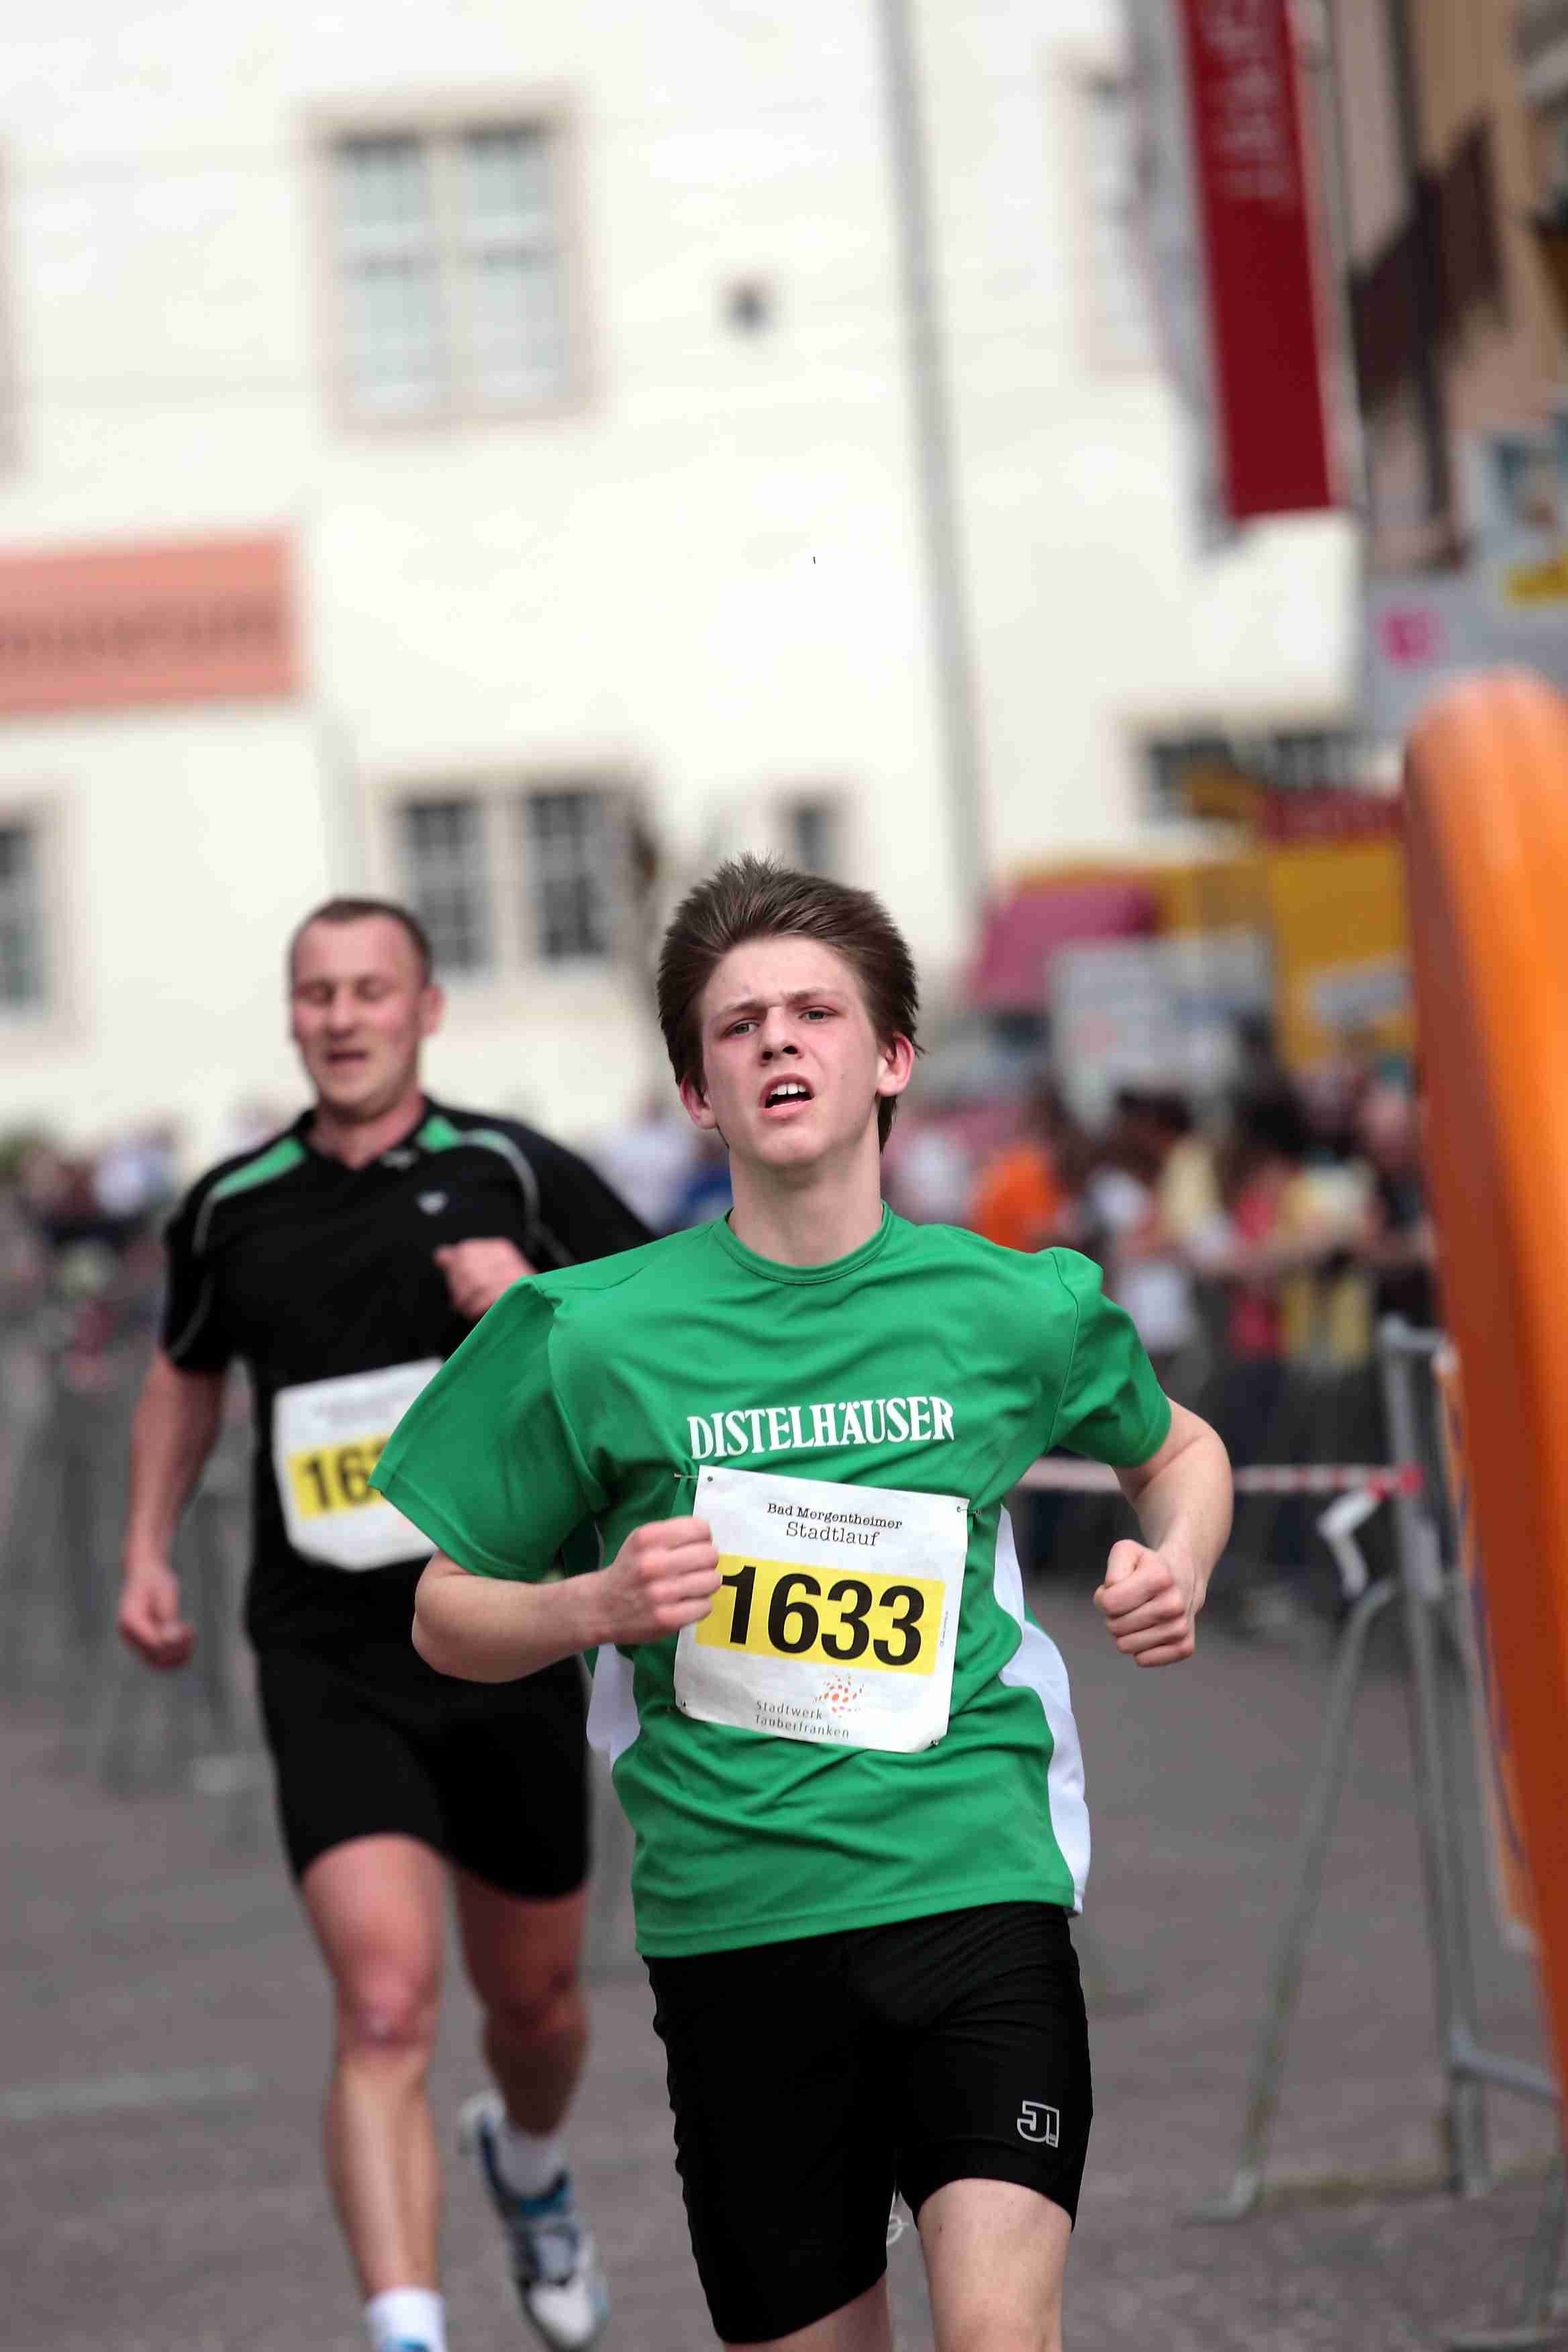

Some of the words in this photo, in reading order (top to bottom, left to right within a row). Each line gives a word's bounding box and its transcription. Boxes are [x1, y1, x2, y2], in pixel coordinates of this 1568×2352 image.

[687, 1395, 955, 1461] DISTELHÄUSER
[767, 1502, 793, 1516] Bad
[786, 1520, 881, 1547] Stadtlauf
[721, 1565, 925, 1667] 1633
[756, 1700, 823, 1720] Stadtwerk
